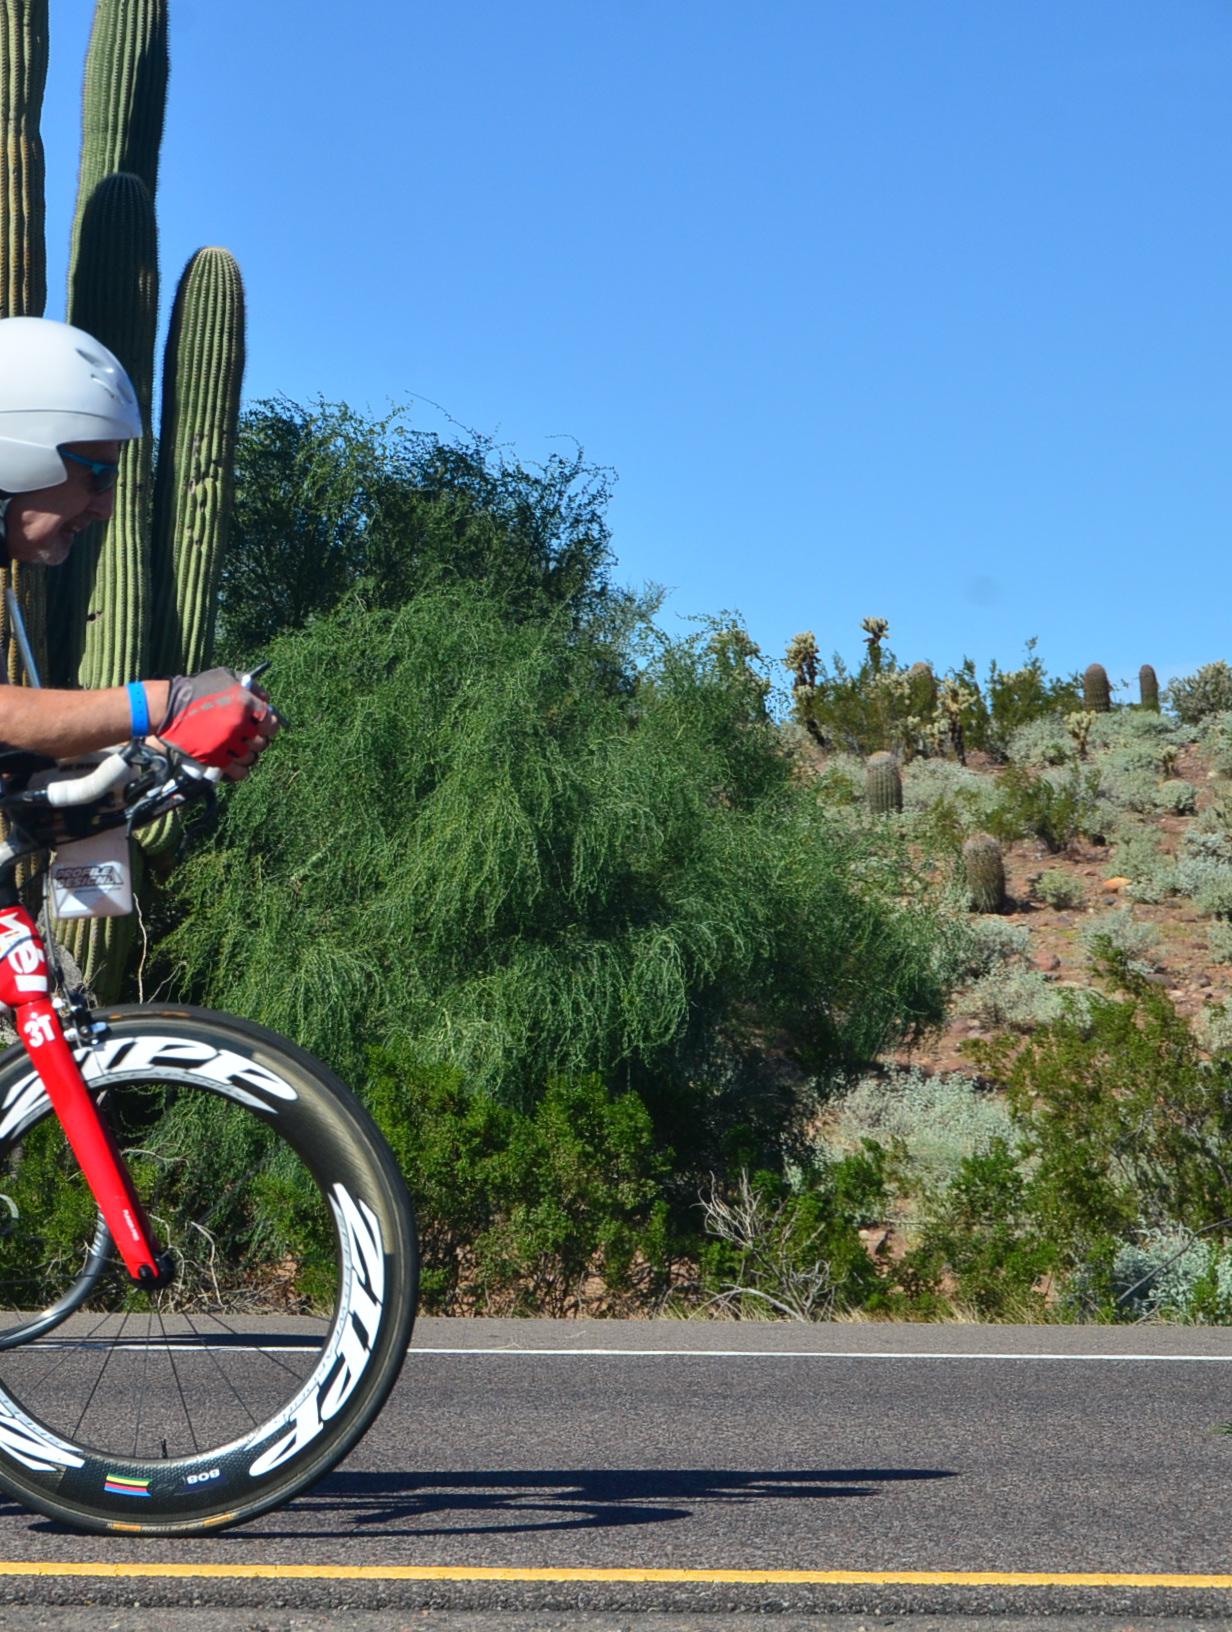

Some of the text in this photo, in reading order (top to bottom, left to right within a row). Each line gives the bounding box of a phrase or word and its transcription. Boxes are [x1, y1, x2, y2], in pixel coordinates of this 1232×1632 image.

[24, 1012, 56, 1048] 3T
[249, 1182, 384, 1477] ZIPP
[186, 1468, 221, 1485] 808
